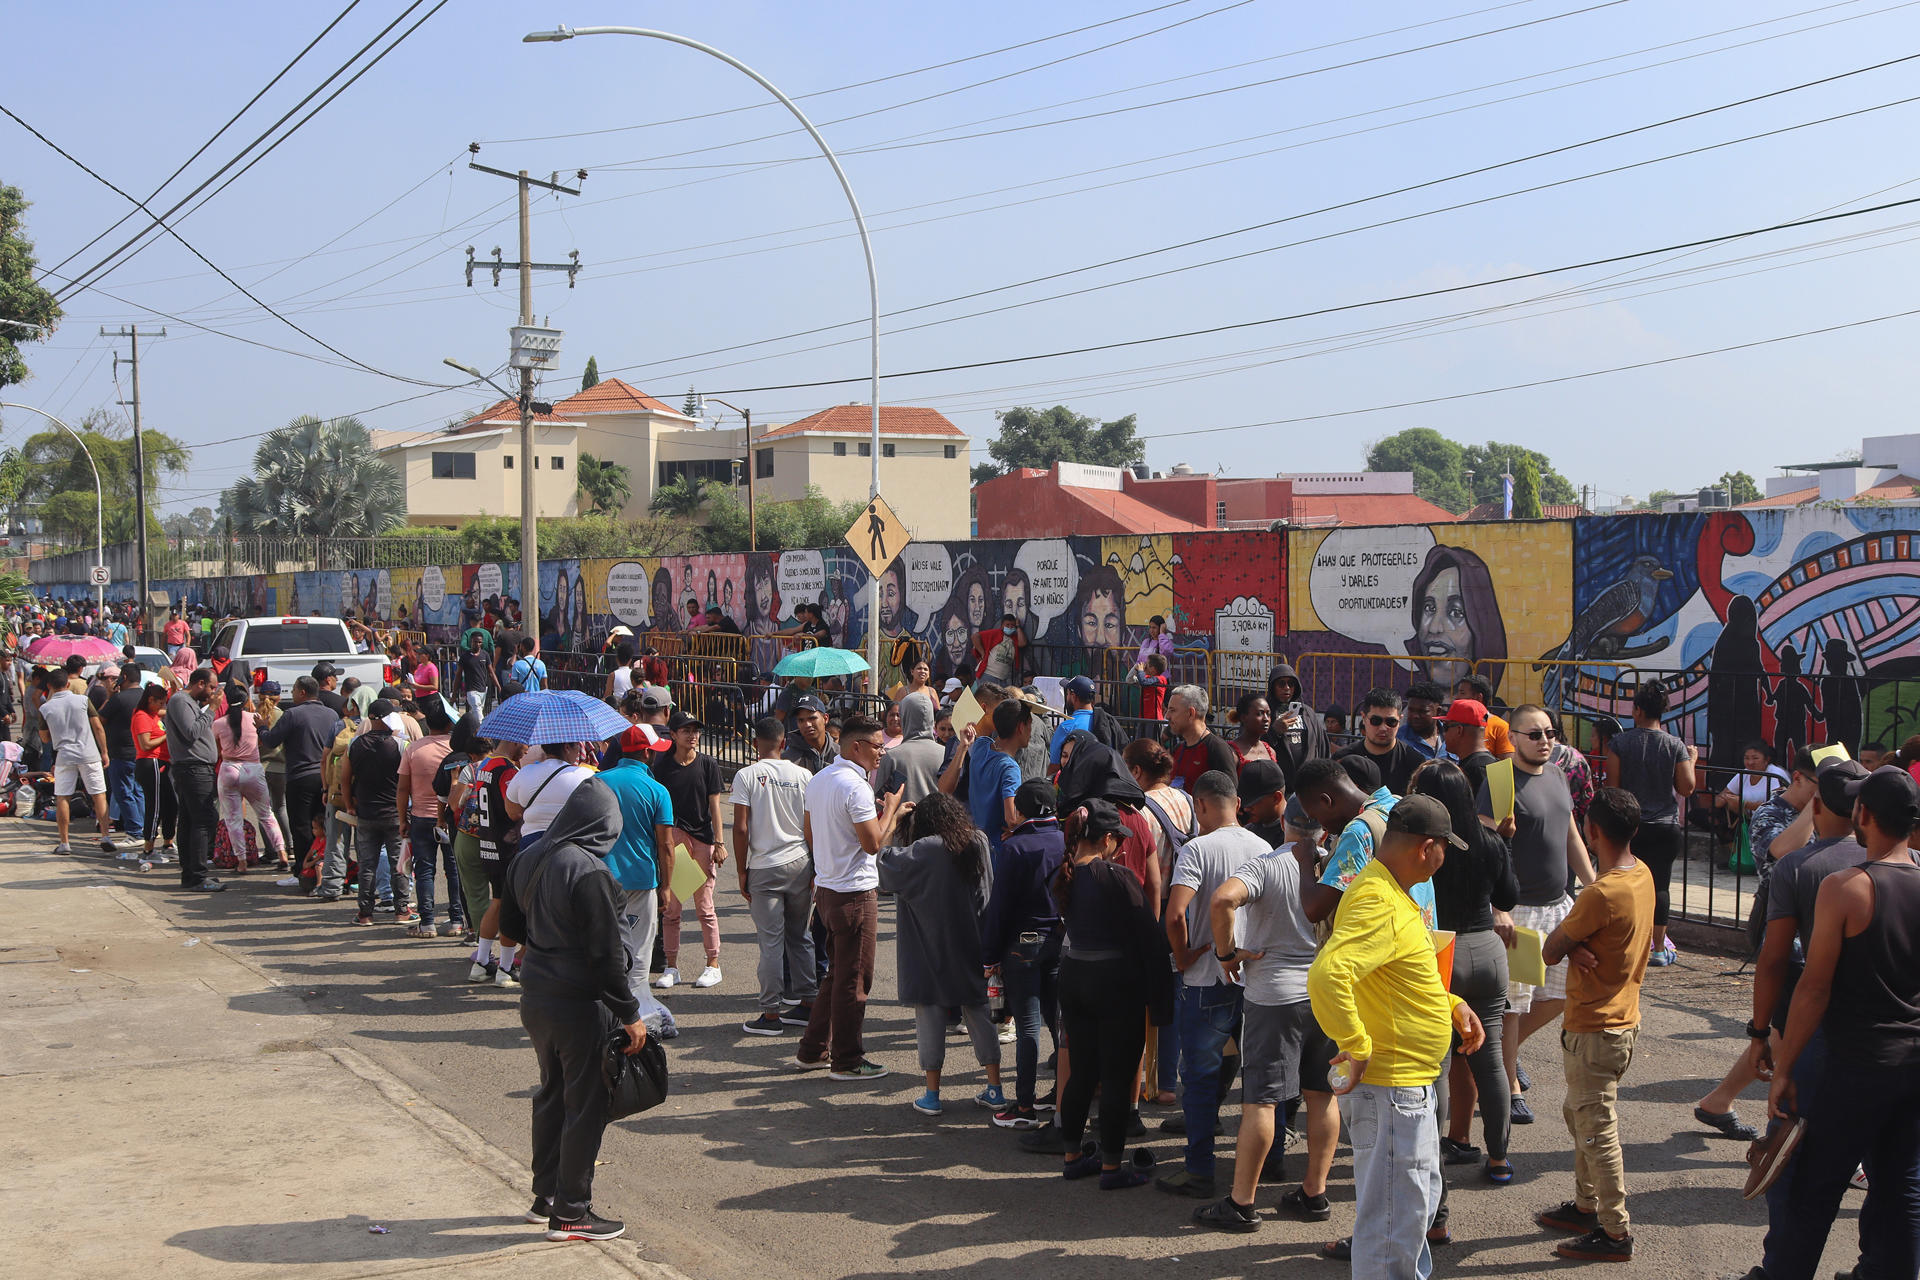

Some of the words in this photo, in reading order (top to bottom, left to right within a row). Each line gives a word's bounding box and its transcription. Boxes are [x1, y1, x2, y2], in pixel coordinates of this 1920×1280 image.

[930, 560, 942, 571] VALE
[1036, 559, 1058, 571] PORQUE
[1339, 555, 1356, 567] QUE
[1361, 552, 1418, 566] PROTEGERLES
[1033, 577, 1052, 588] #ANTE
[1053, 577, 1068, 588] TODO
[1341, 574, 1347, 588] Y
[1348, 574, 1379, 588] DARLES
[1033, 595, 1046, 606] SON
[1046, 592, 1065, 605] NIÑOS
[1258, 622, 1268, 631] KM
[1240, 635, 1249, 646] de
[479, 786, 490, 828] 9
